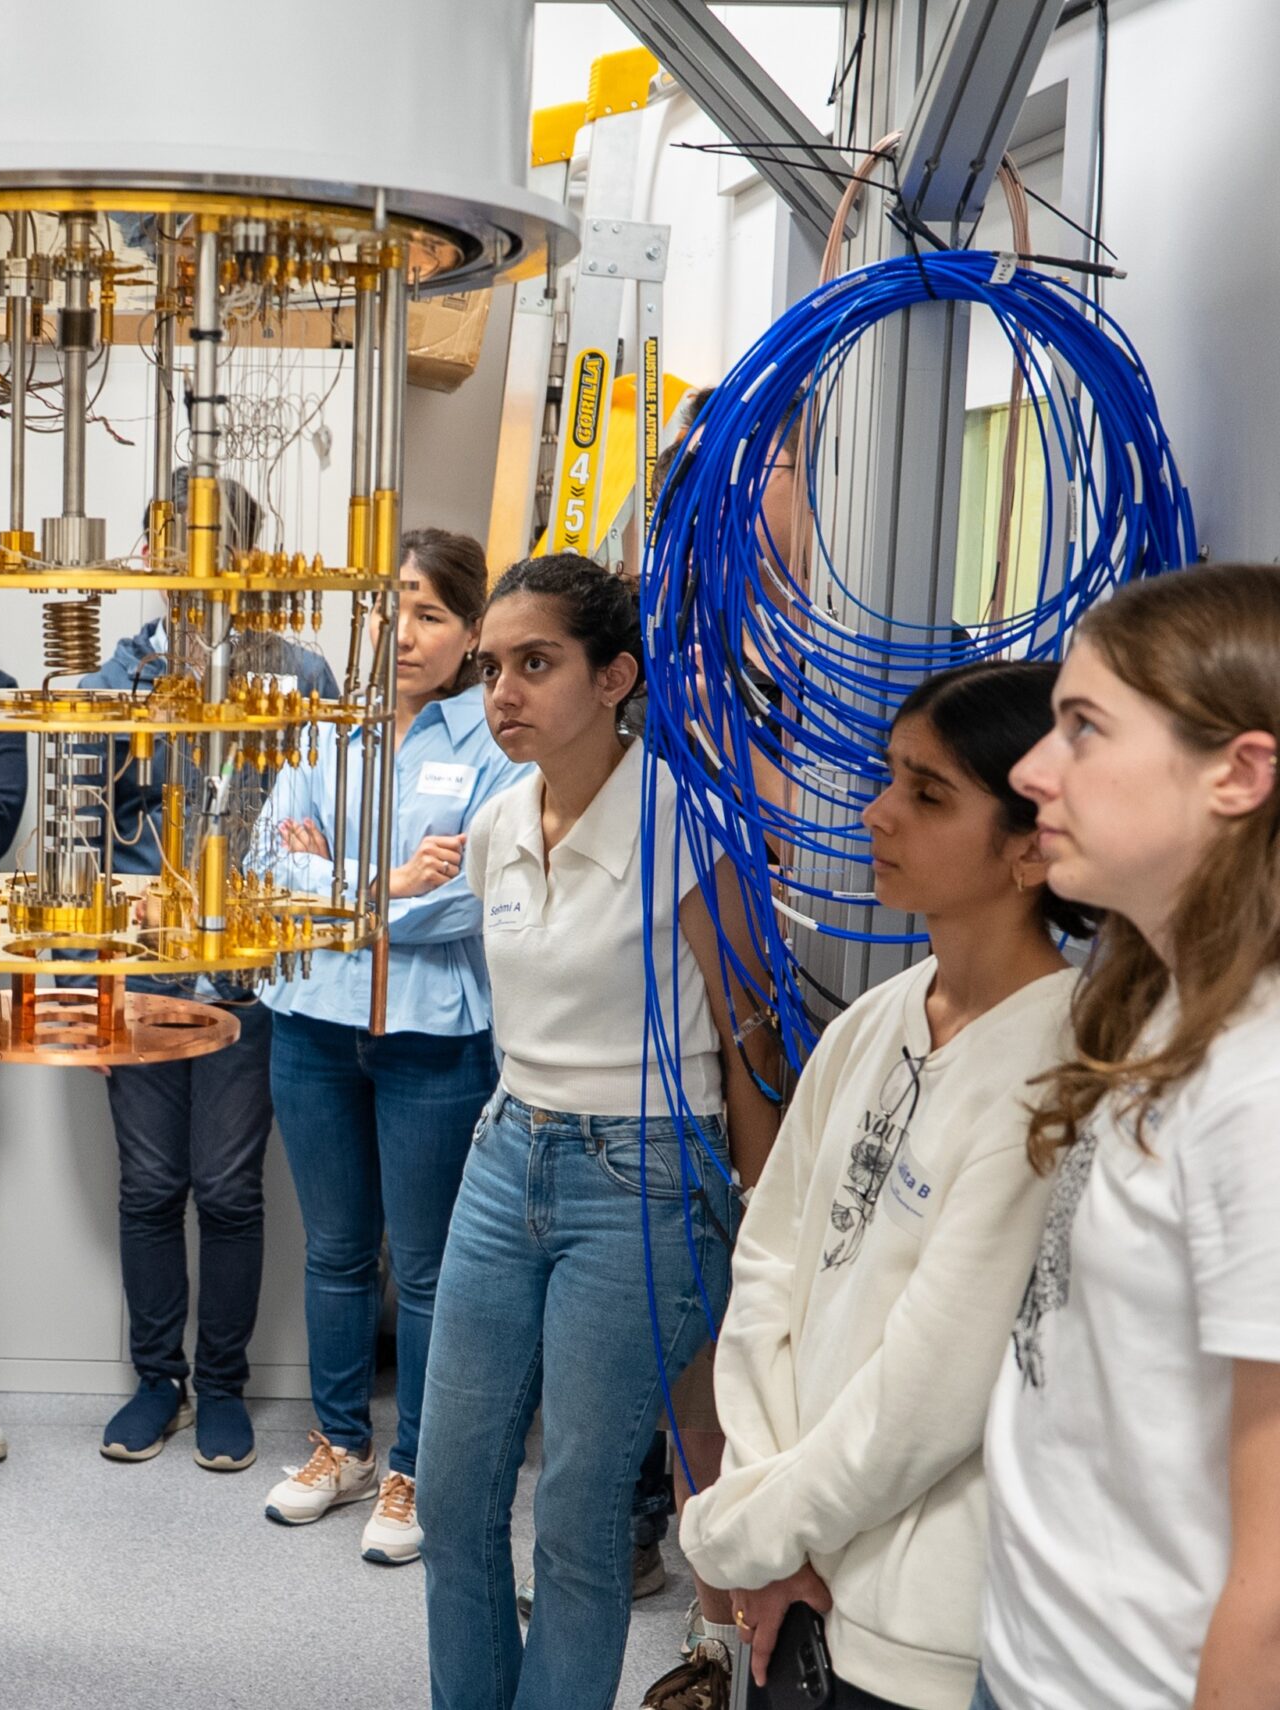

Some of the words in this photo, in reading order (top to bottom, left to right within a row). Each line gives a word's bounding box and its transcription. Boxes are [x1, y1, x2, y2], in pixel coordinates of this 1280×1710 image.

[645, 339, 658, 402] ADJUSTABLE
[576, 355, 602, 445] GORILLA
[645, 403, 658, 458] PLATFORM
[569, 452, 590, 486] 4
[564, 499, 585, 533] 5
[513, 901, 521, 912] A
[917, 1183, 931, 1199] B
